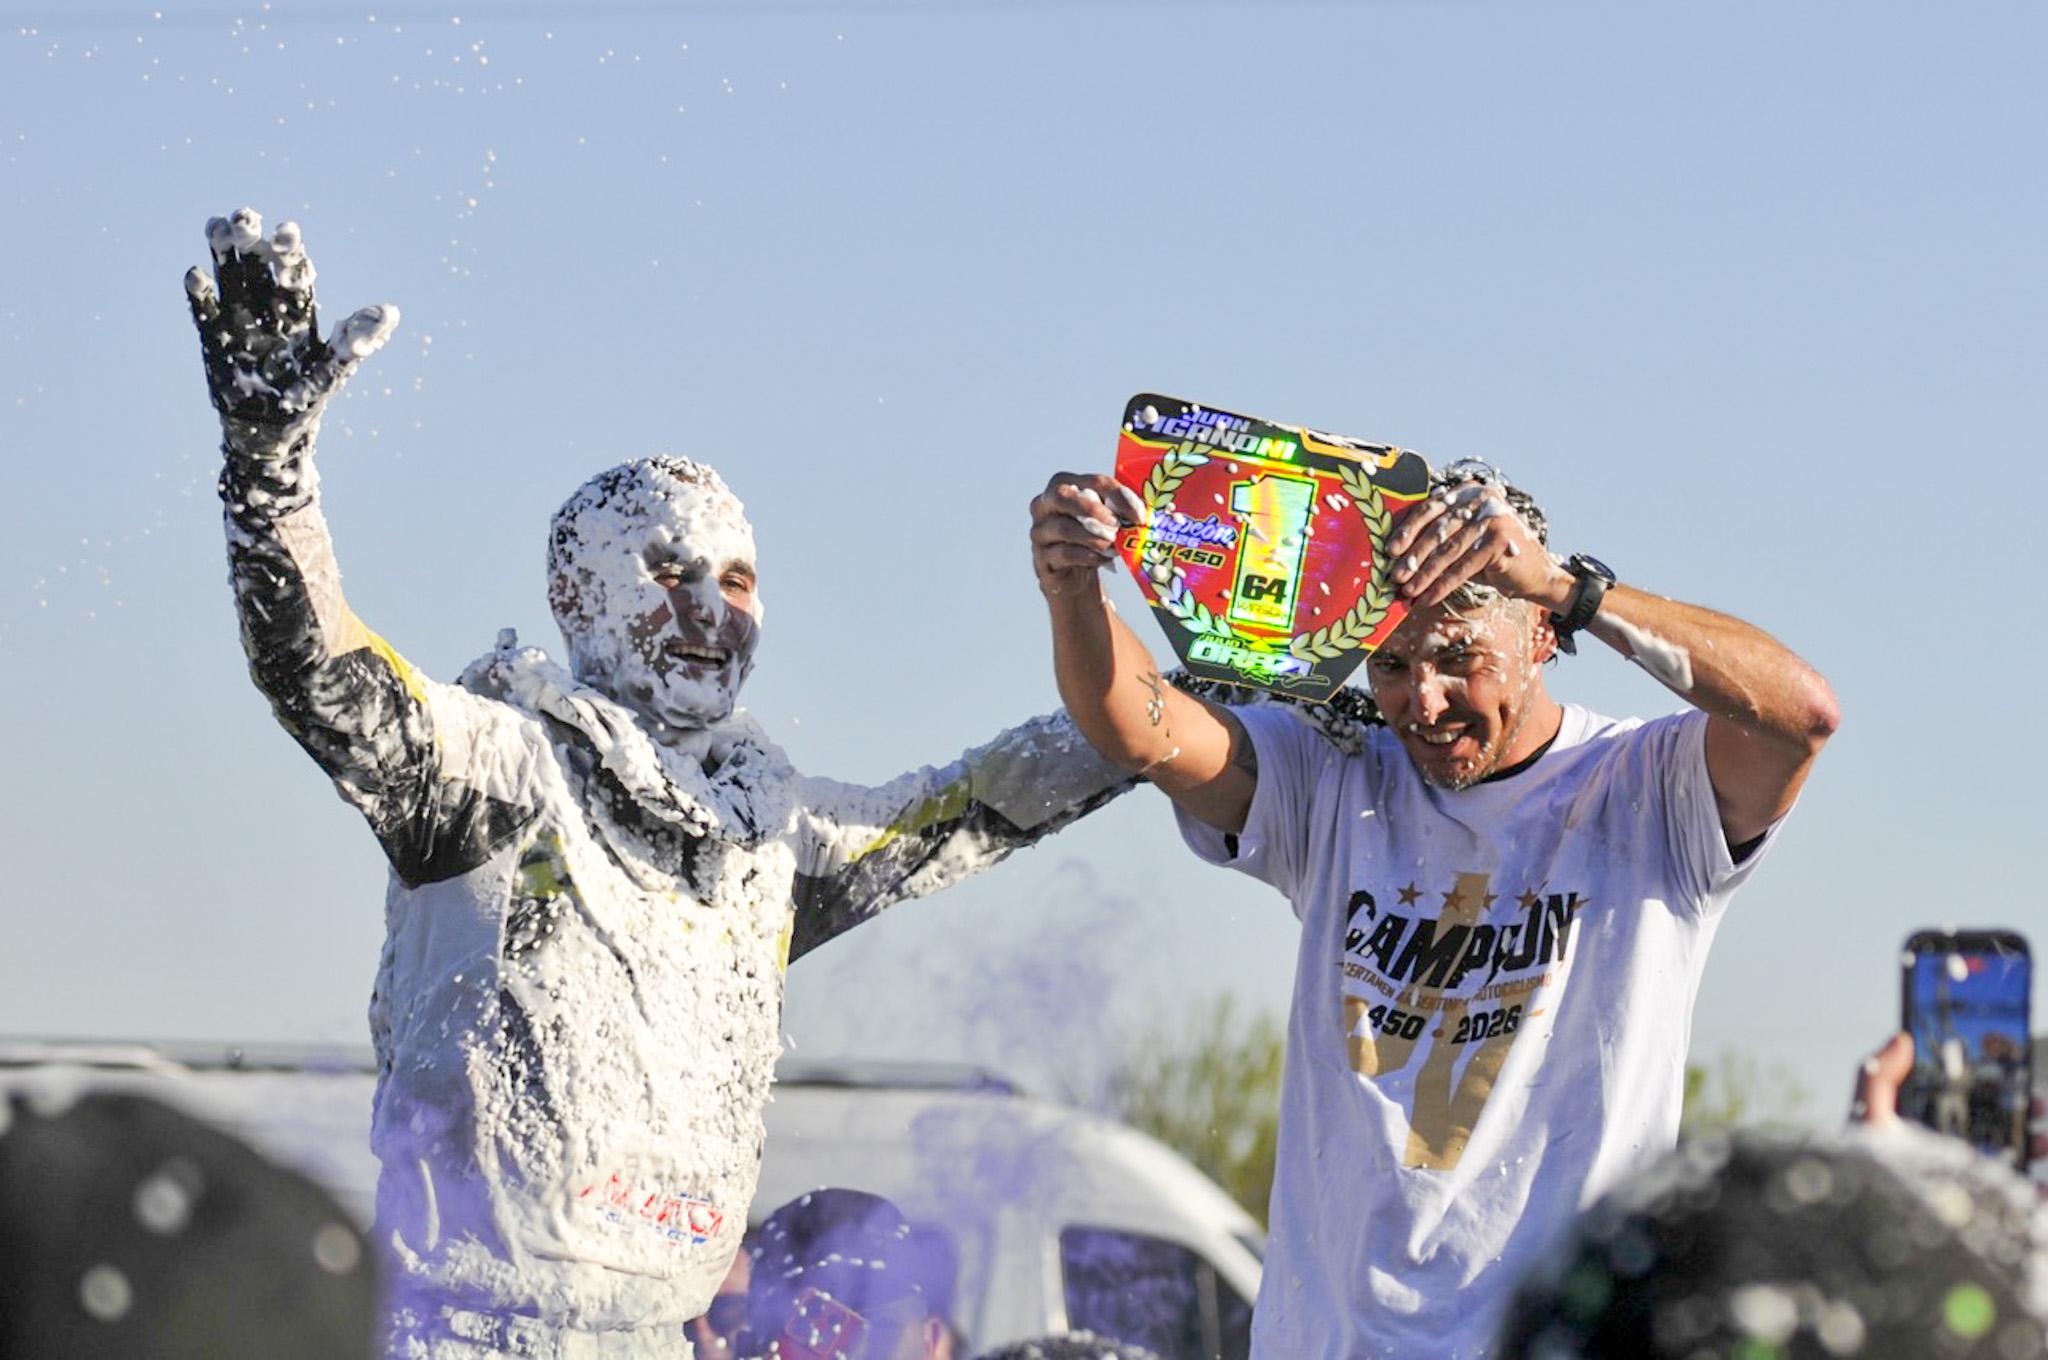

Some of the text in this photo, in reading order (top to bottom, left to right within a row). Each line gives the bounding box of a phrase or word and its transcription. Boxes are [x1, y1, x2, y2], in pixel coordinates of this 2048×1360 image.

[1182, 408, 1250, 432] JUAN
[1178, 549, 1224, 567] 450
[1229, 471, 1317, 632] 1
[1241, 575, 1287, 604] 64
[1368, 1004, 1523, 1045] 450 2026
